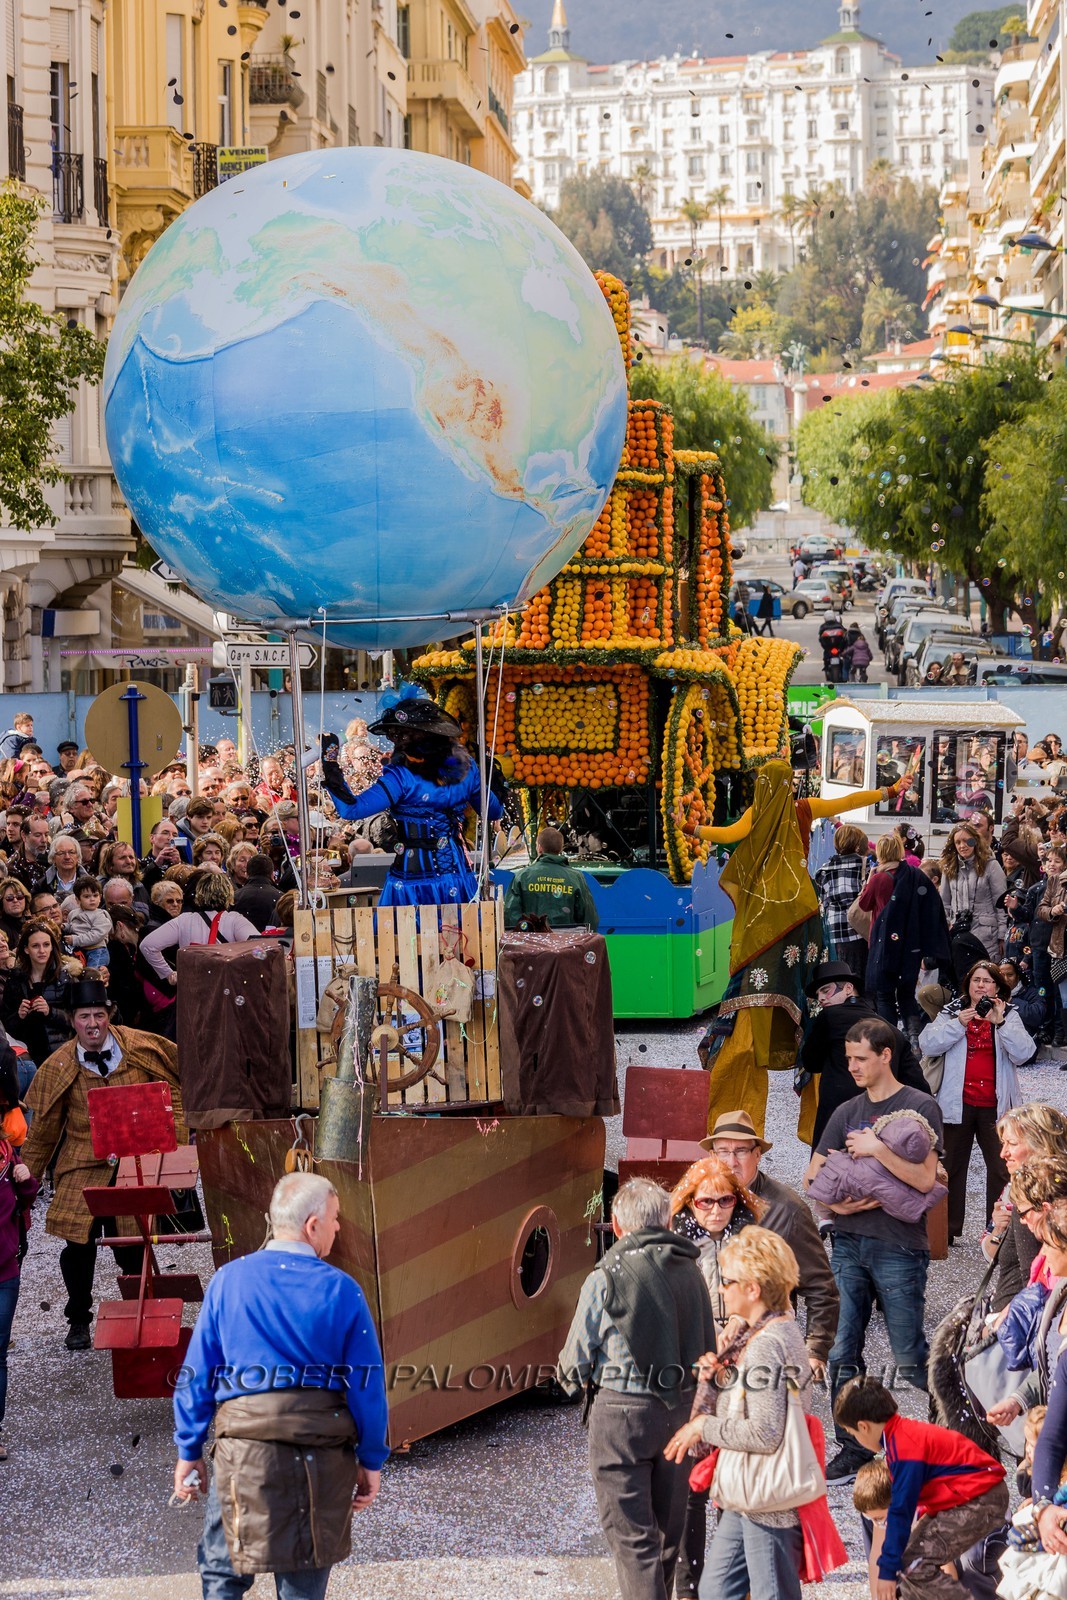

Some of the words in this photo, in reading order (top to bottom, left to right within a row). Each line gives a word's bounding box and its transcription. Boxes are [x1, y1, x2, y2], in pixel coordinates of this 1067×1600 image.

[230, 649, 250, 661] Gare
[254, 649, 288, 661] S.N.C.F.
[528, 883, 573, 895] CONTROLE
